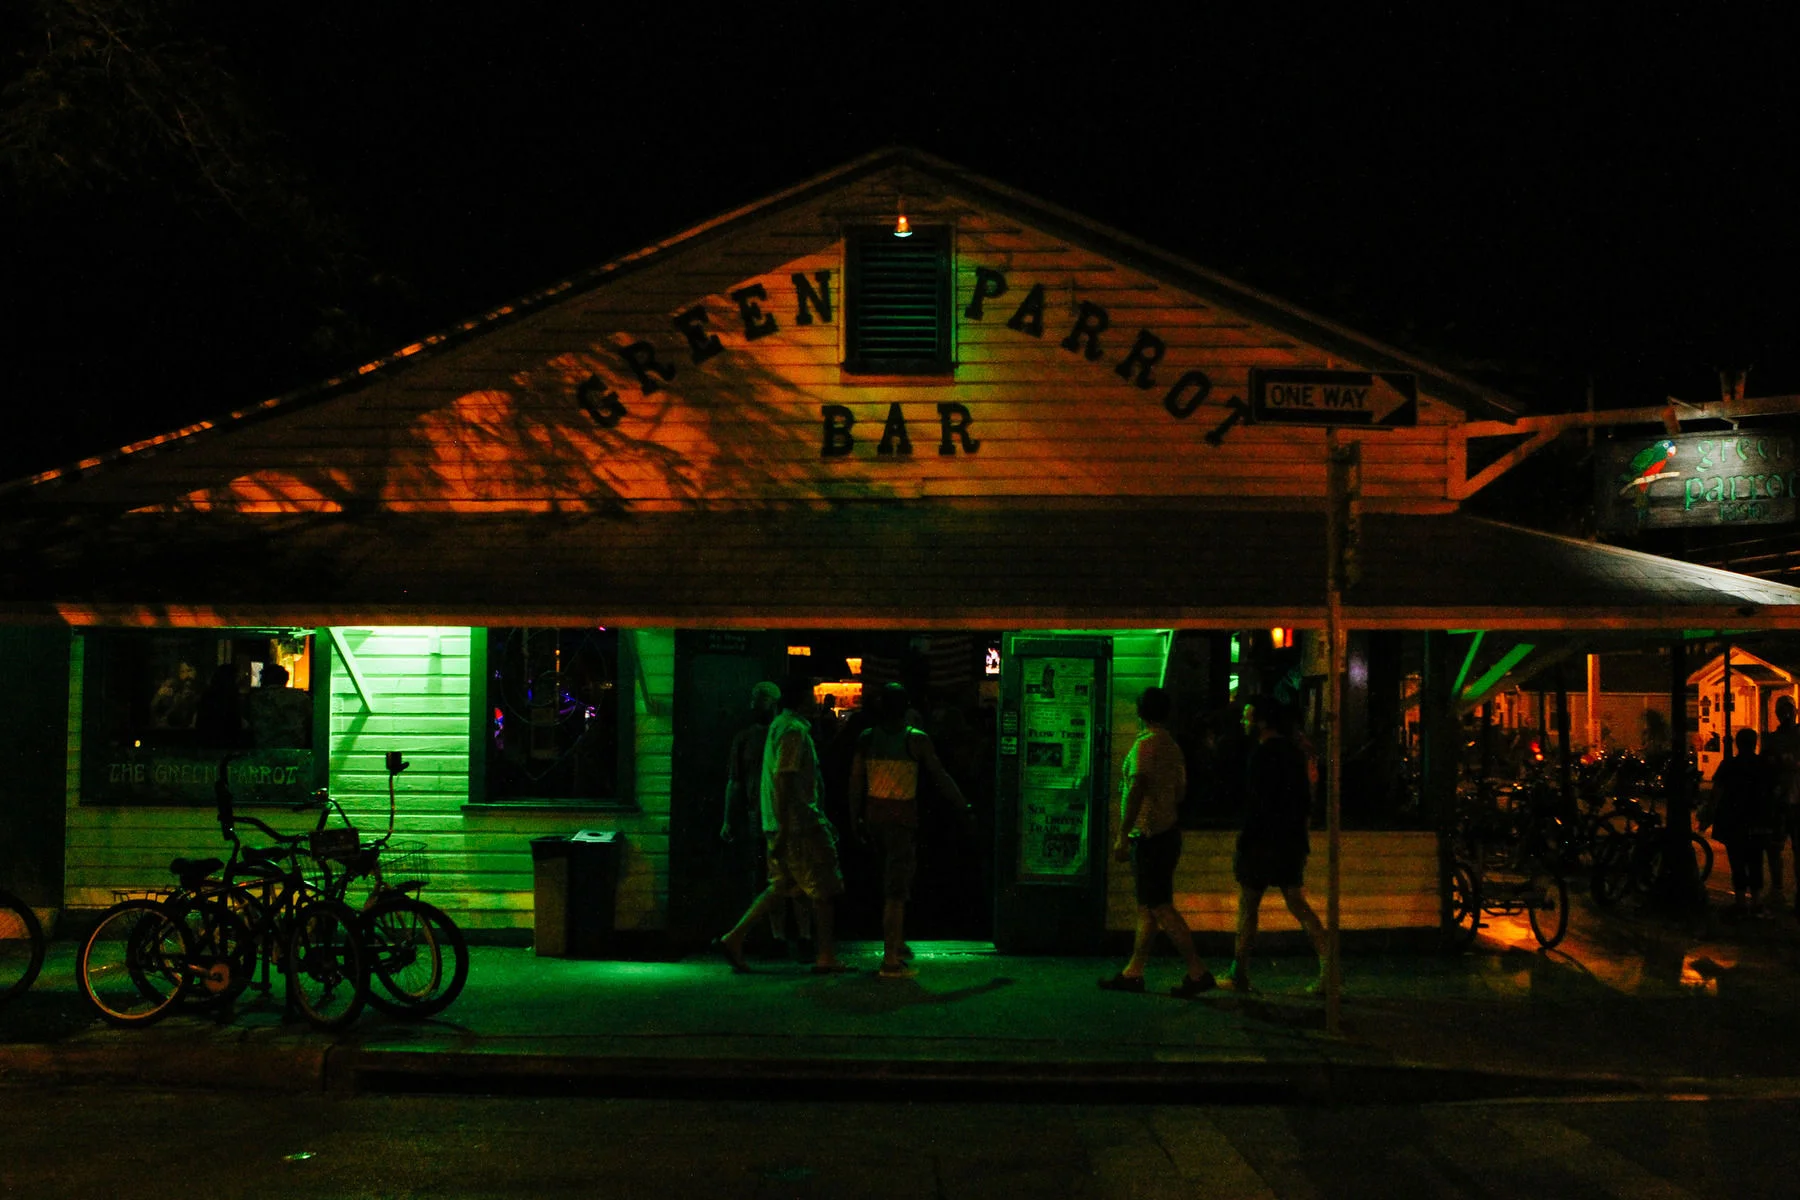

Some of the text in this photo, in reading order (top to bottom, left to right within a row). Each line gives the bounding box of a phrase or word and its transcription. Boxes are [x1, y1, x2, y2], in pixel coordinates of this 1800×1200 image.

[575, 267, 1249, 444] GREEN PARROT
[1271, 385, 1367, 409] ONE WAY
[822, 402, 980, 459] BAR
[109, 763, 146, 784] THE
[154, 764, 220, 785] GREEN
